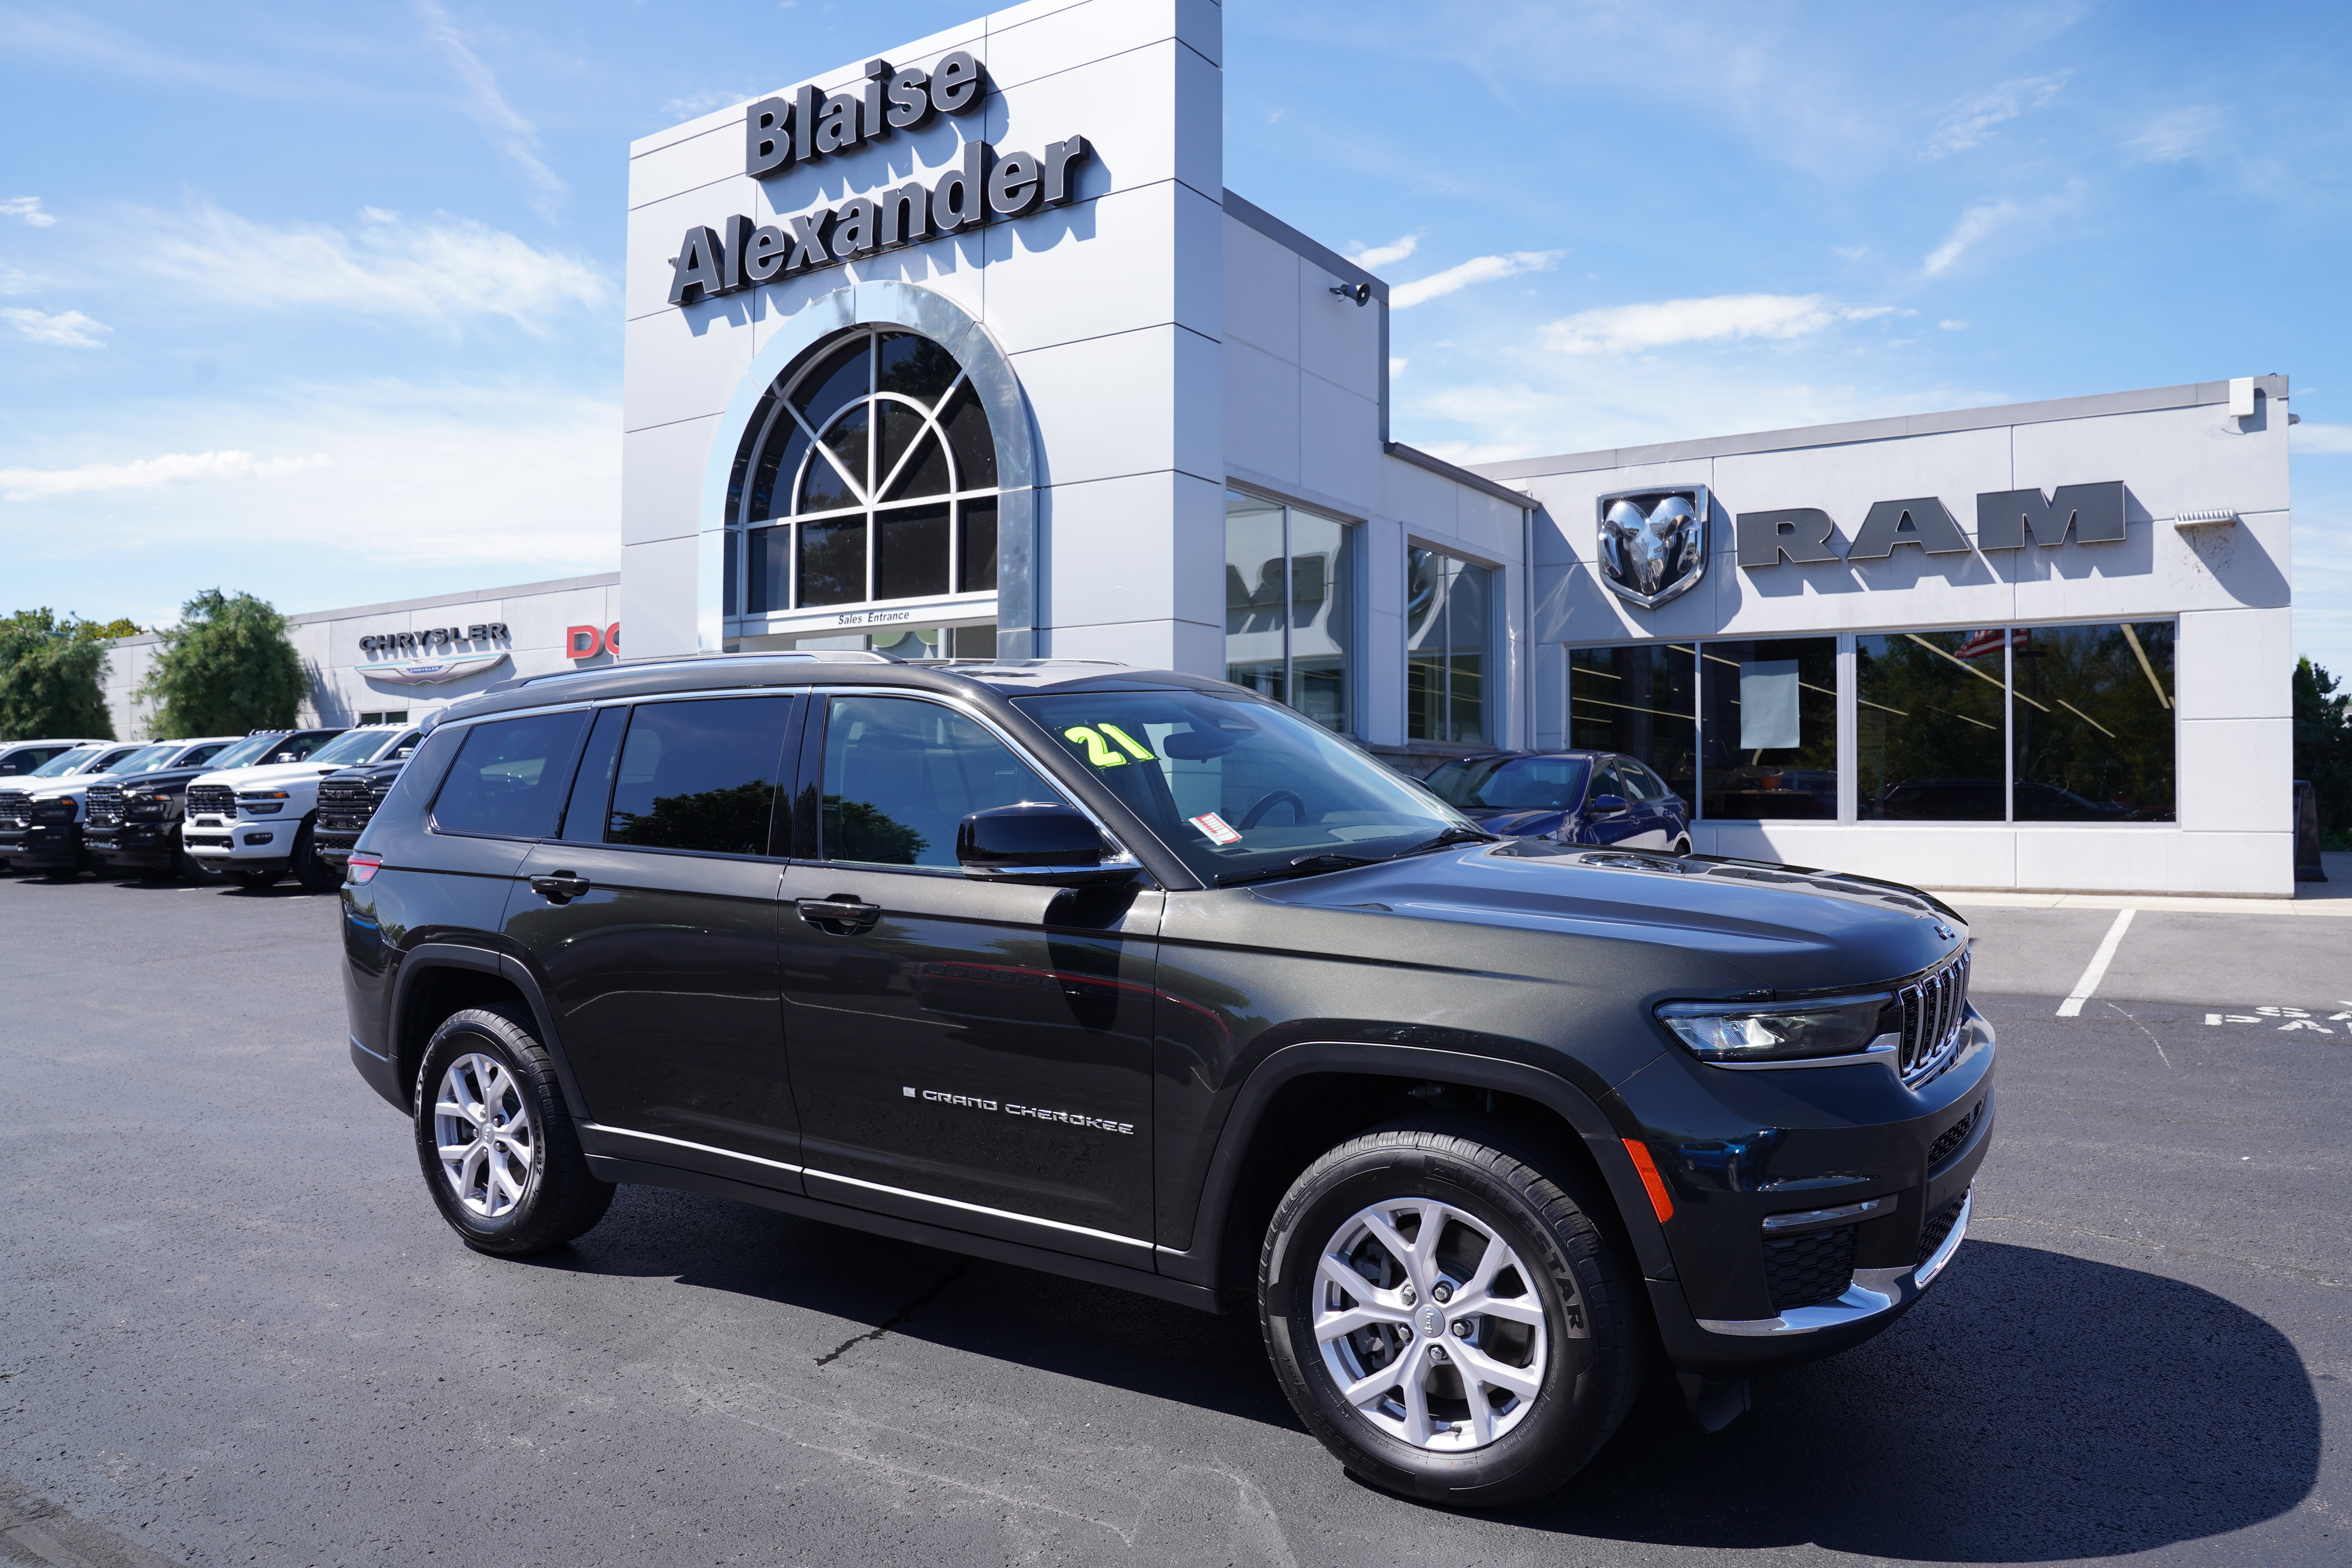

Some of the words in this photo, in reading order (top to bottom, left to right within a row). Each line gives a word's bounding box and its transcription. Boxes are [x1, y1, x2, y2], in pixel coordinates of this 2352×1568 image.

[746, 51, 986, 179] Blaise
[668, 134, 1090, 306] Alexander
[1736, 480, 2126, 568] RAM
[359, 623, 508, 652] CHRYSLER
[838, 614, 862, 625] Sales
[868, 611, 910, 623] Entrance
[1065, 724, 1155, 767] 21
[326, 790, 354, 798] RAM
[923, 1090, 998, 1111] GRAND
[1005, 1104, 1134, 1134] CHEROKEE
[1461, 1171, 1584, 1330] MILESTAR
[1424, 1308, 1434, 1334] Jeep
[1377, 1439, 1389, 1449] DOT
